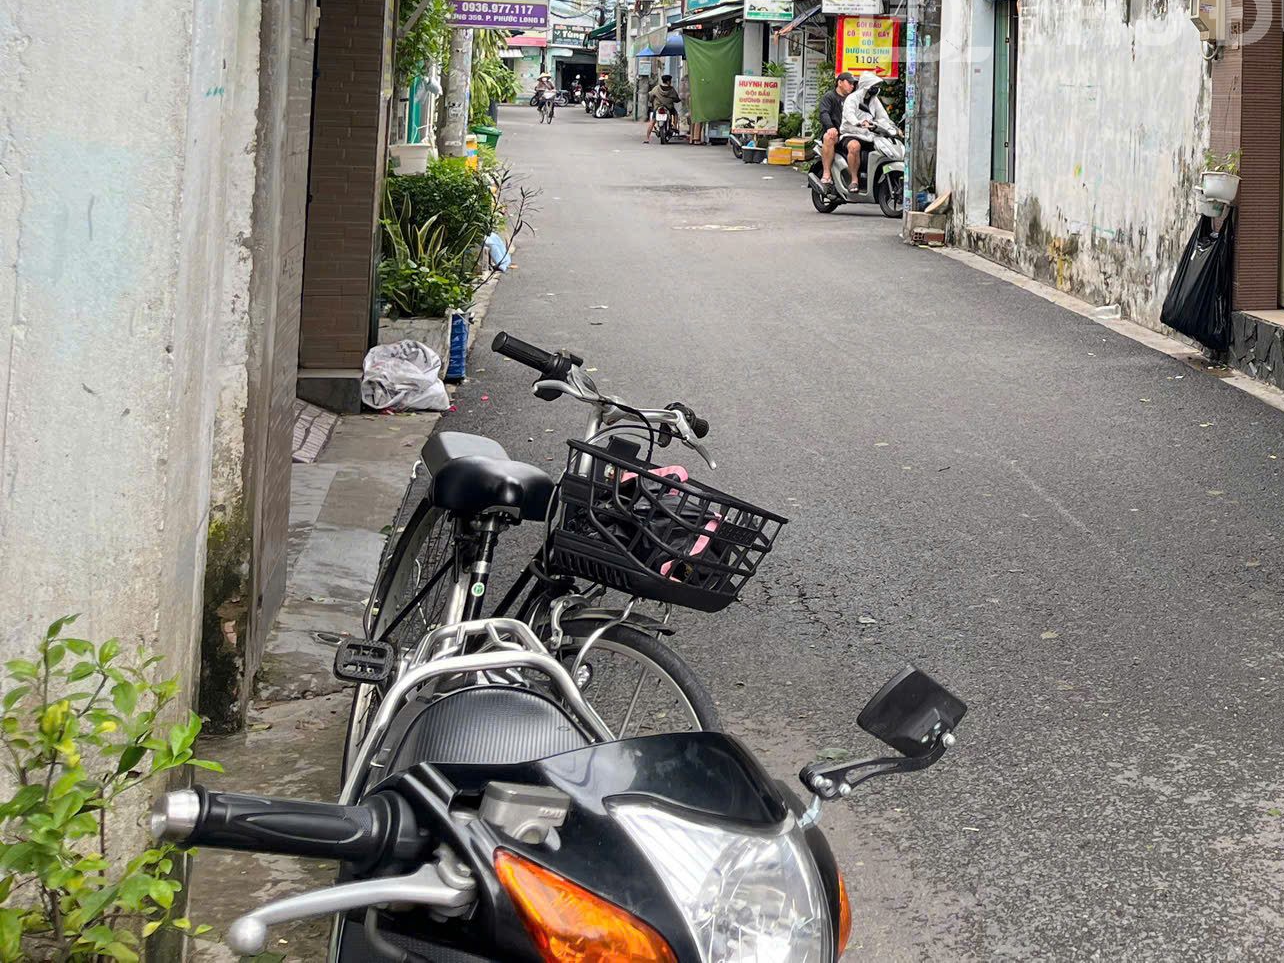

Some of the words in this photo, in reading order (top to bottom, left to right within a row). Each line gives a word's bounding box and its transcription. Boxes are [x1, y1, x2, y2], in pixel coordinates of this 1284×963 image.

[462, 1, 534, 14] 0936.977.117
[519, 16, 539, 24] LONG
[855, 55, 879, 64] 110K
[763, 81, 778, 89] NGA
